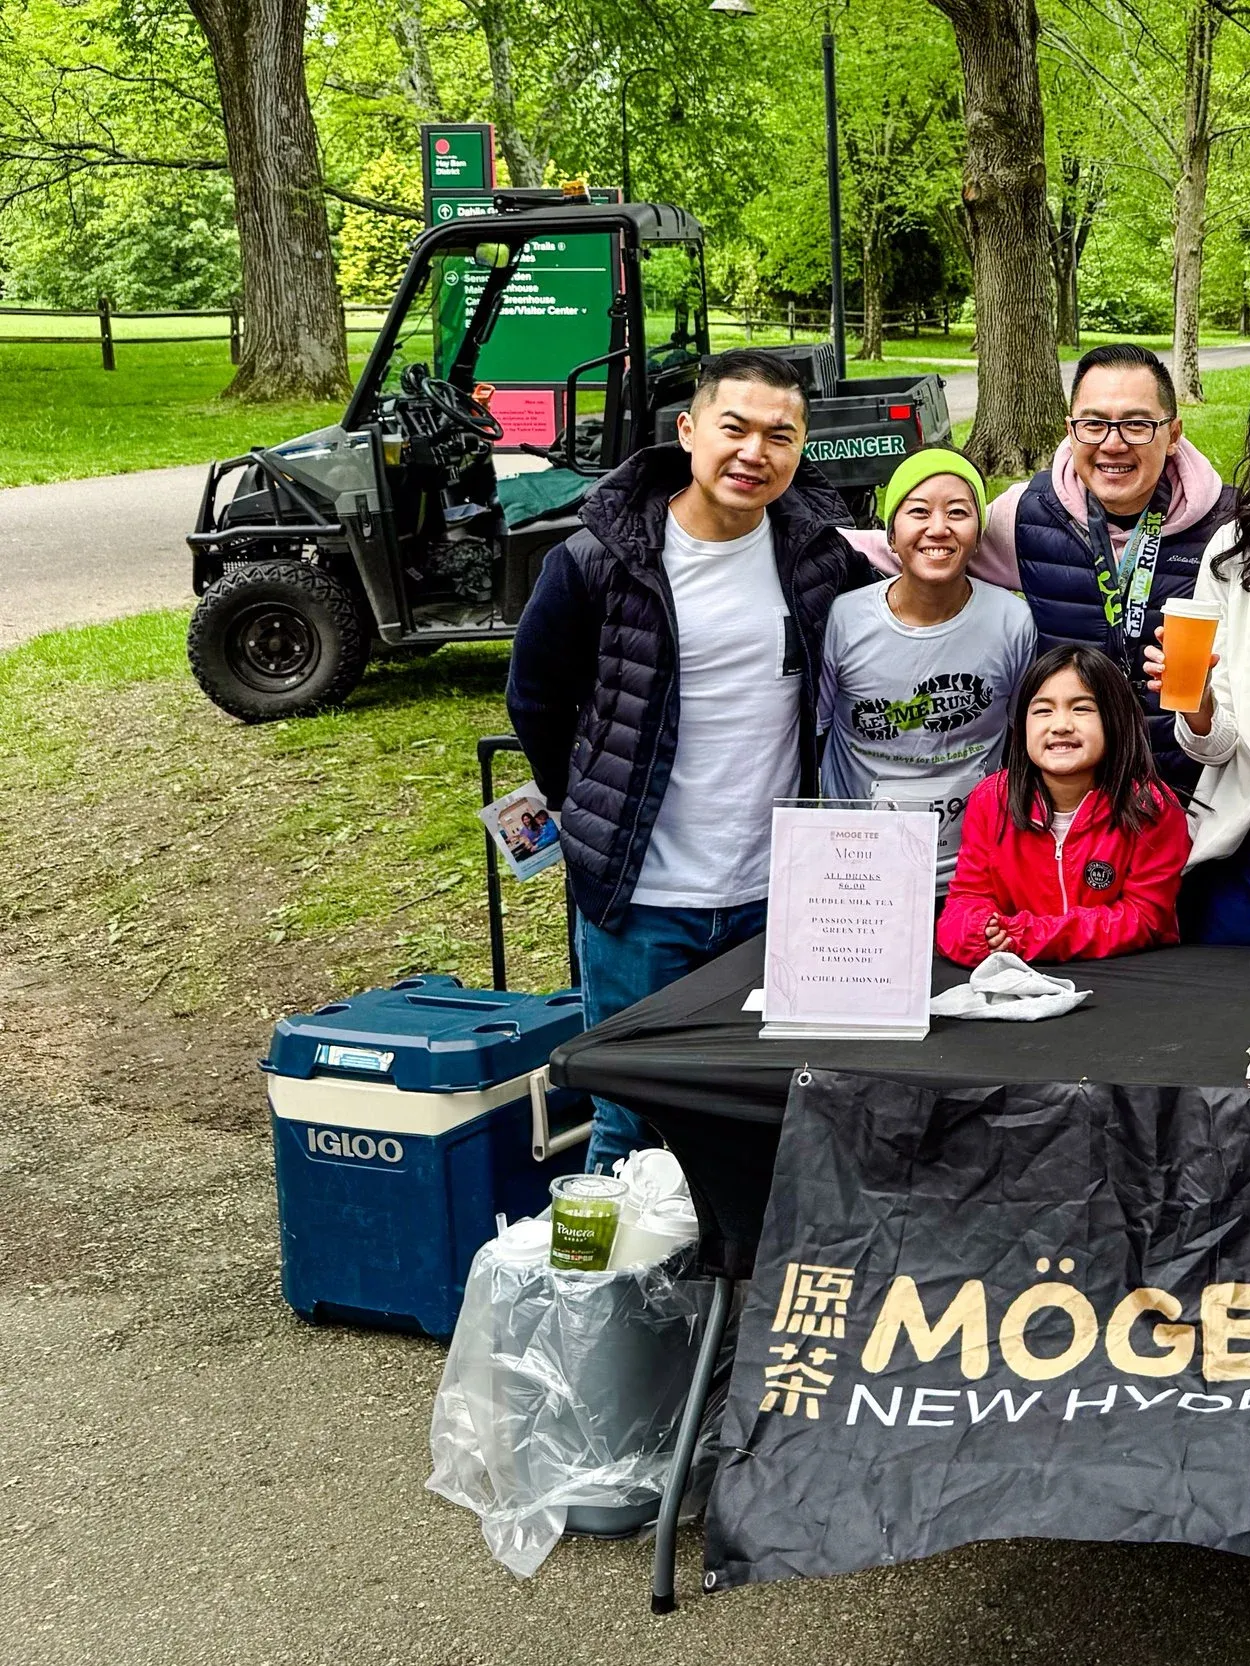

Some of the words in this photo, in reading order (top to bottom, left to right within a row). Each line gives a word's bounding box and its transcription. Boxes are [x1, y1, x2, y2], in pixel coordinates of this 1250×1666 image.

[892, 701, 929, 723] ME
[931, 694, 972, 714] RUN
[931, 755, 946, 764] the
[947, 751, 968, 762] Long
[968, 744, 985, 755] Run
[835, 847, 872, 859] Menu
[845, 873, 881, 881] DRINKS
[849, 898, 871, 906] MILK
[801, 975, 836, 983] LYCHEE
[840, 976, 892, 984] LEMONADE
[307, 1128, 404, 1163] IGLOO
[556, 1221, 595, 1237] Panera
[846, 1384, 1043, 1427] NEW
